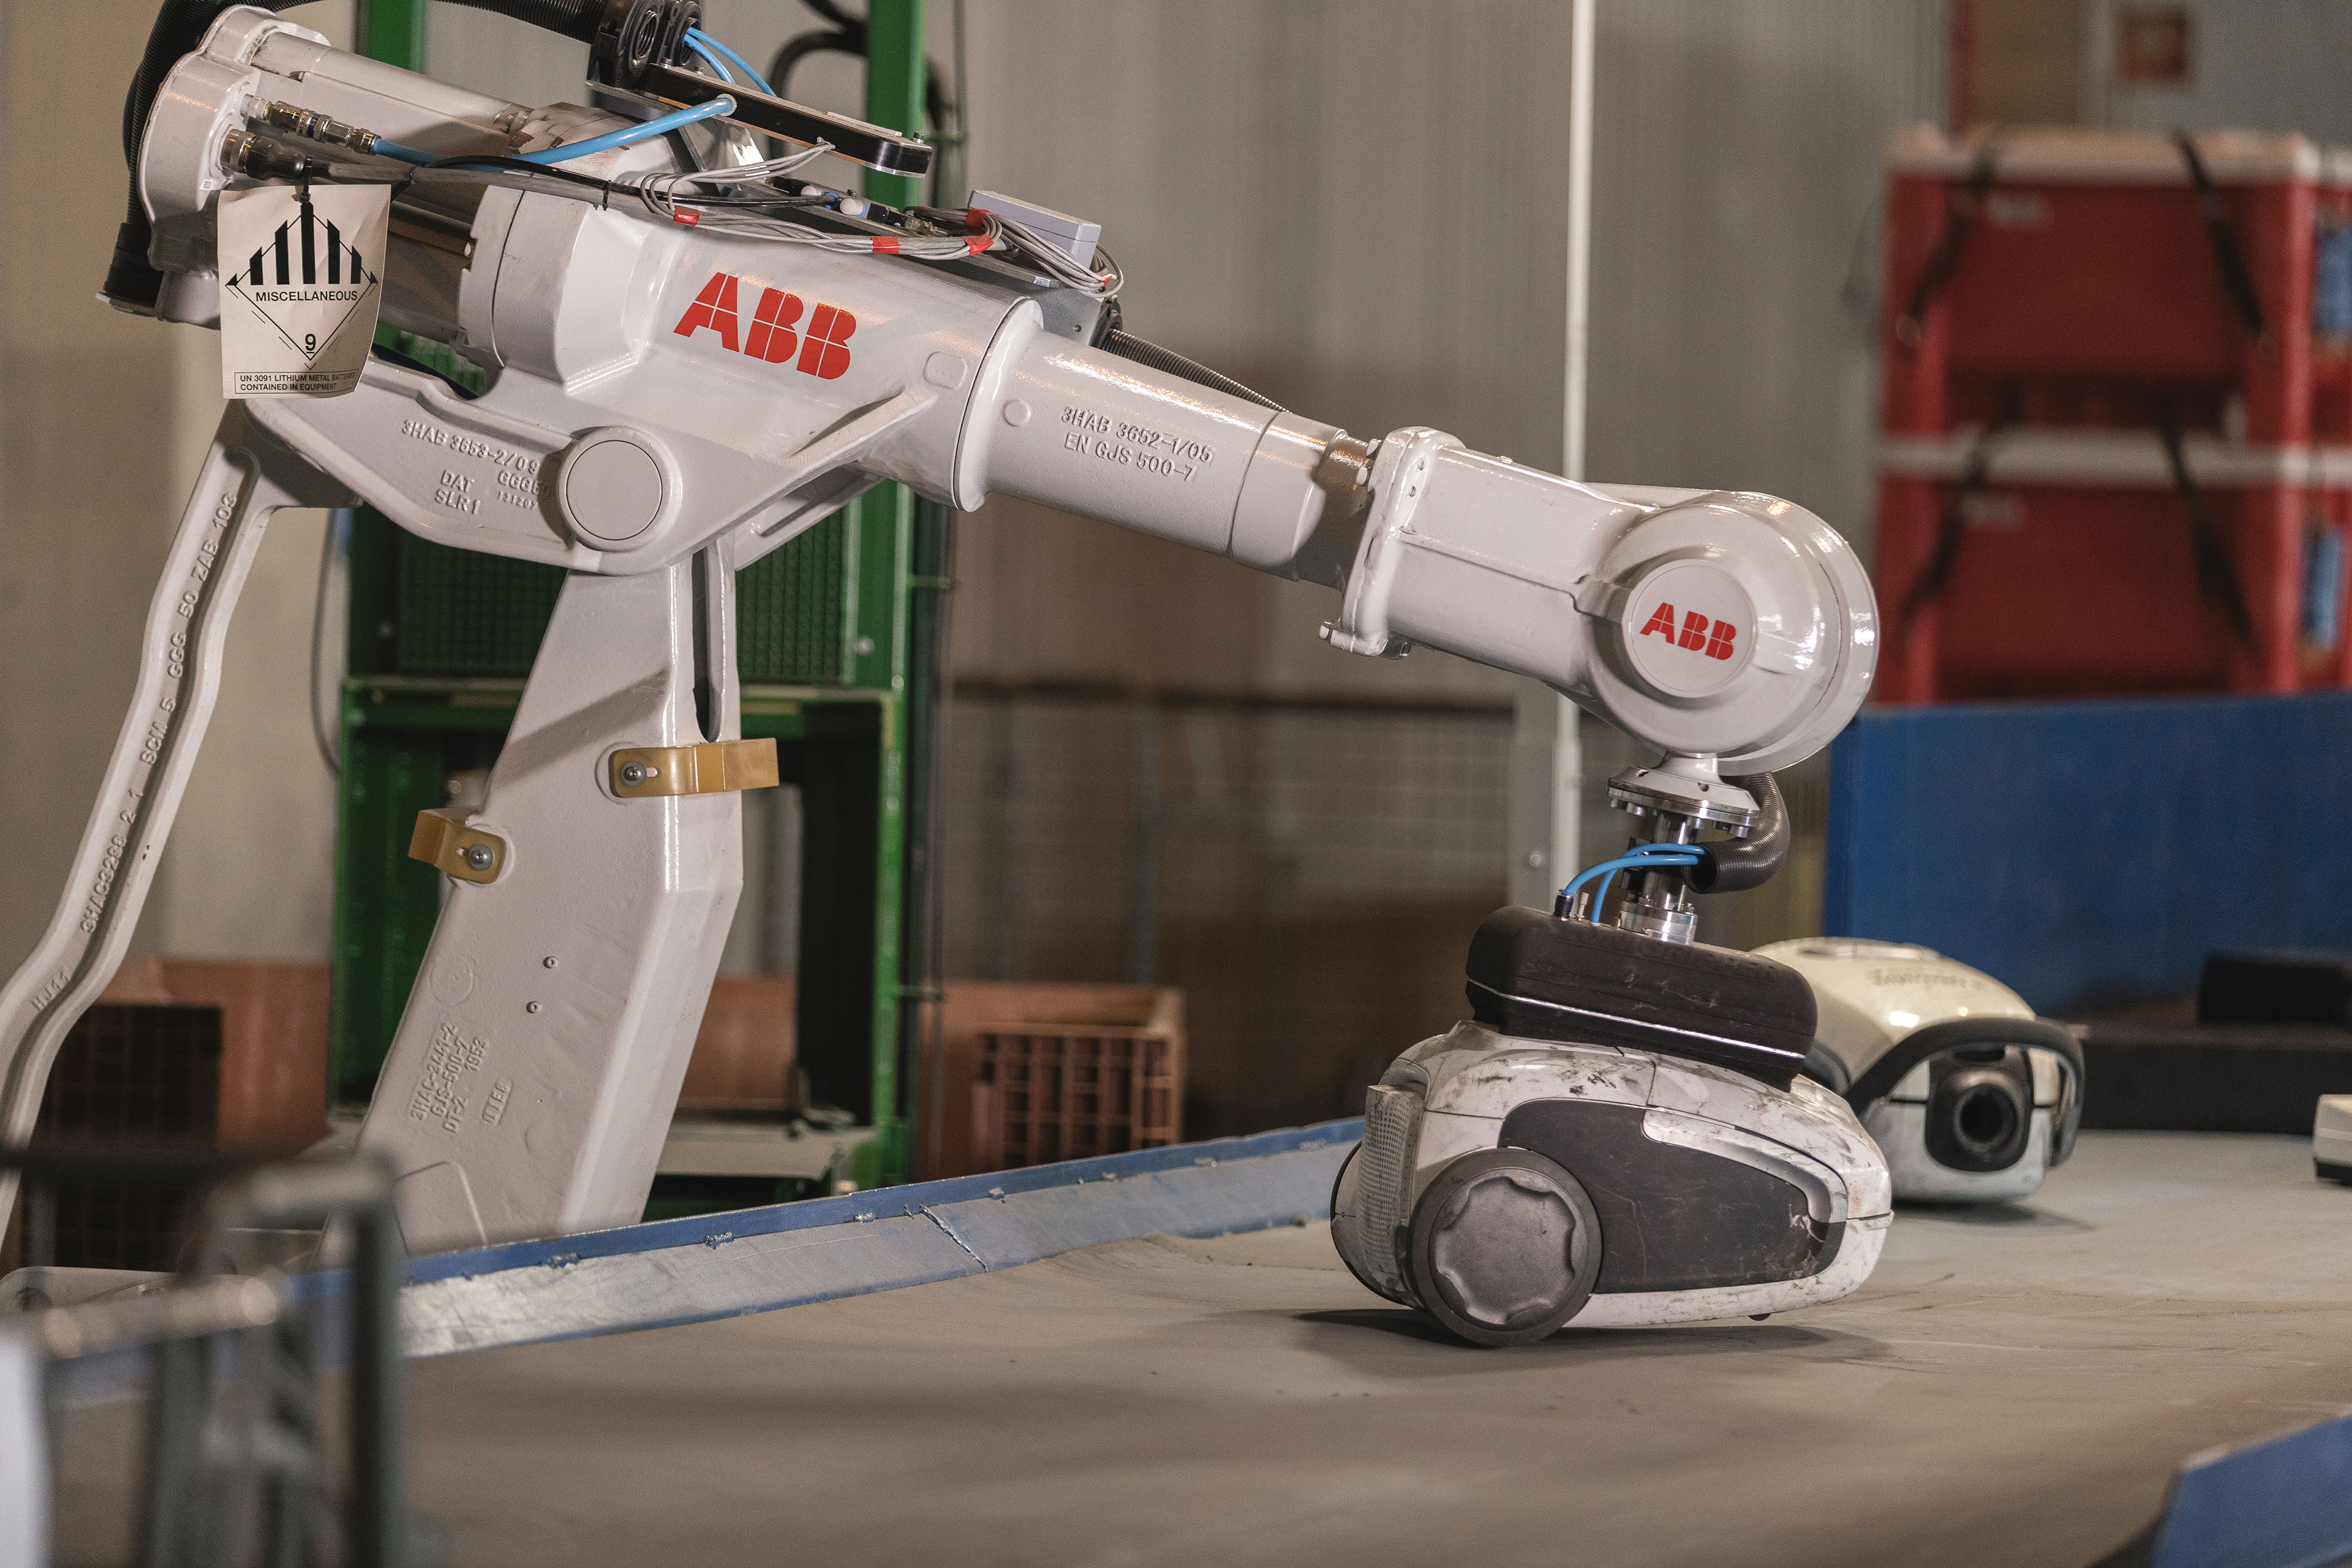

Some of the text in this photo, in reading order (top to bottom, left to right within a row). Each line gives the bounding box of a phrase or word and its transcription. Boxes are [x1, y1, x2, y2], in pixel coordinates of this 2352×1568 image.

[256, 291, 357, 301] MISCELLANEOUS
[305, 334, 316, 351] 9
[674, 273, 856, 379] ABB
[331, 372, 356, 381] BATTERIES
[402, 420, 447, 445] 3HAB
[1061, 407, 1215, 463] 3HAB 3652-1/05
[1065, 431, 1197, 481] EN GJS 500-7
[441, 470, 473, 492] DAT
[167, 632, 186, 678] GGG
[177, 590, 199, 619] 50
[212, 492, 237, 527] 103
[1640, 602, 1736, 660] ABB
